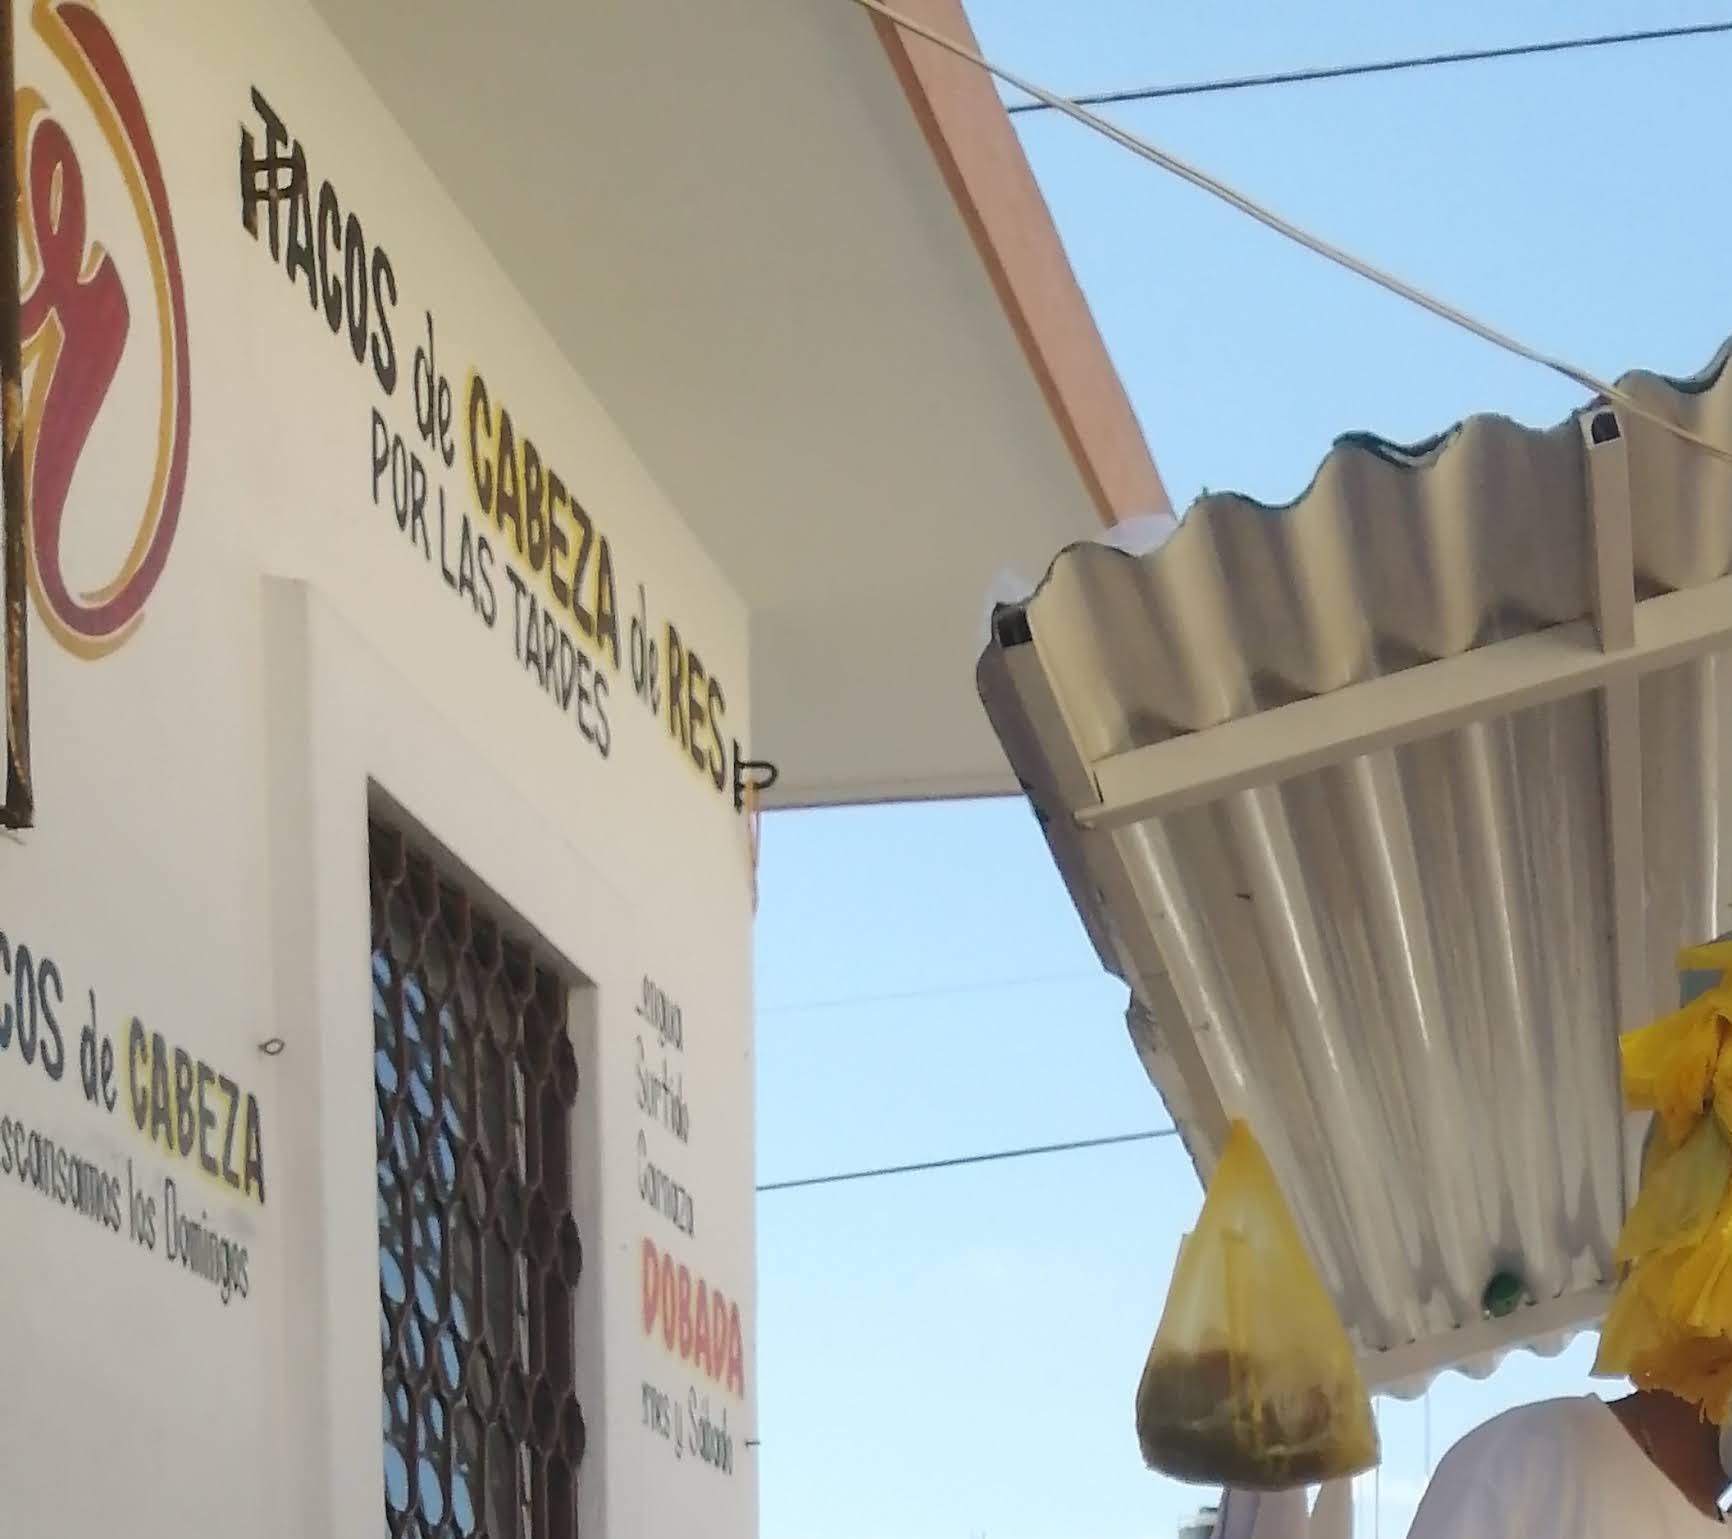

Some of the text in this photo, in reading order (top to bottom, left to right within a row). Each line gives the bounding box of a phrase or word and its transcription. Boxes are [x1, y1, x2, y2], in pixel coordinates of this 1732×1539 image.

[372, 405, 611, 760] POR LAS TARDES
[414, 310, 454, 468] de
[467, 372, 621, 671] CABEZA
[631, 583, 661, 716] de
[667, 622, 726, 794] RES
[80, 987, 117, 1113] de
[128, 1015, 265, 1205] CABEZA
[636, 1033, 689, 1146] Surtido
[128, 1156, 156, 1250] los
[165, 1176, 249, 1306] Domingos
[641, 1235, 744, 1401] DOBADA
[674, 1399, 685, 1463] y
